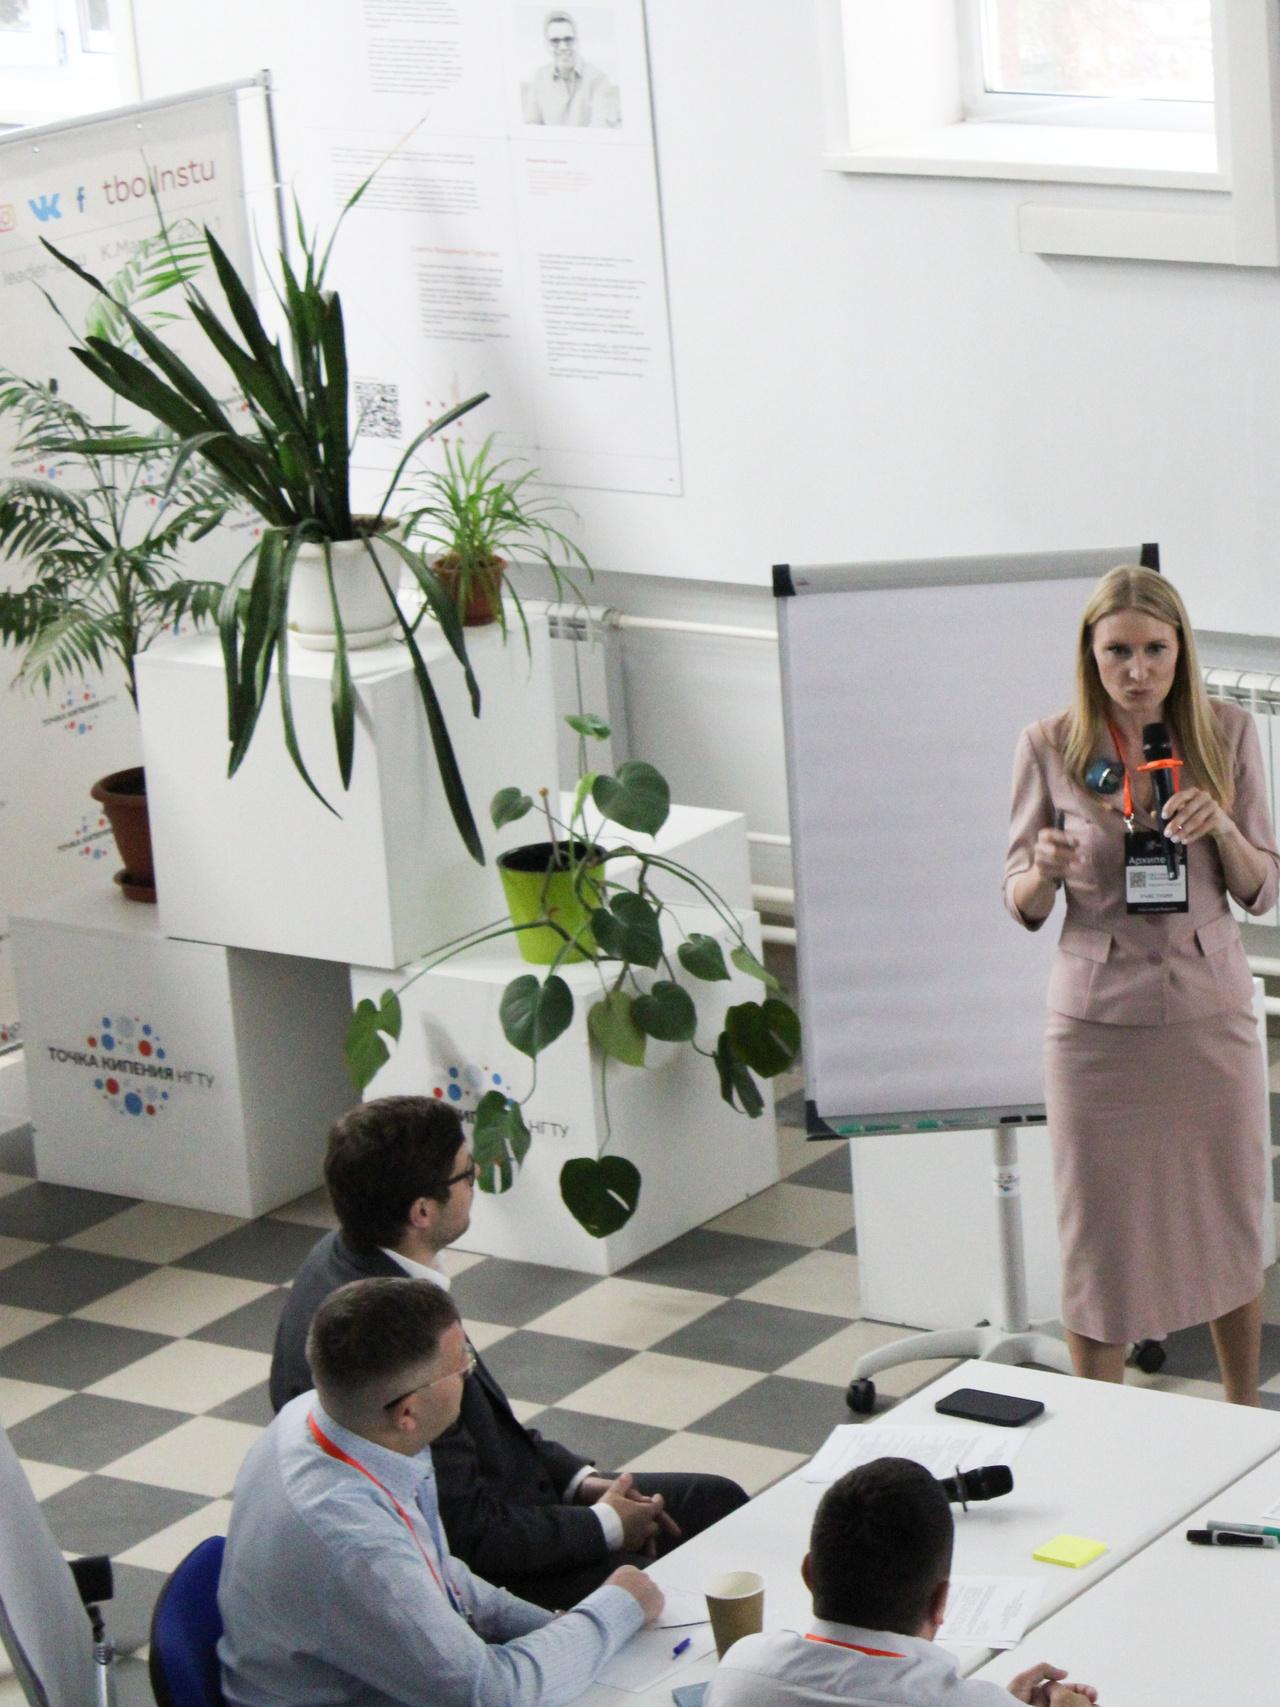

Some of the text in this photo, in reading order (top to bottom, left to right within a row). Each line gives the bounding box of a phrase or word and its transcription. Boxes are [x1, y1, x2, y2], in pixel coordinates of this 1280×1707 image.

[103, 160, 216, 205] tbolnstu
[1128, 856, 1183, 867] Архипег
[48, 1046, 215, 1089] ТОЧКА КИПЕНИЯ НГТУ
[529, 1120, 570, 1138] НГТУ
